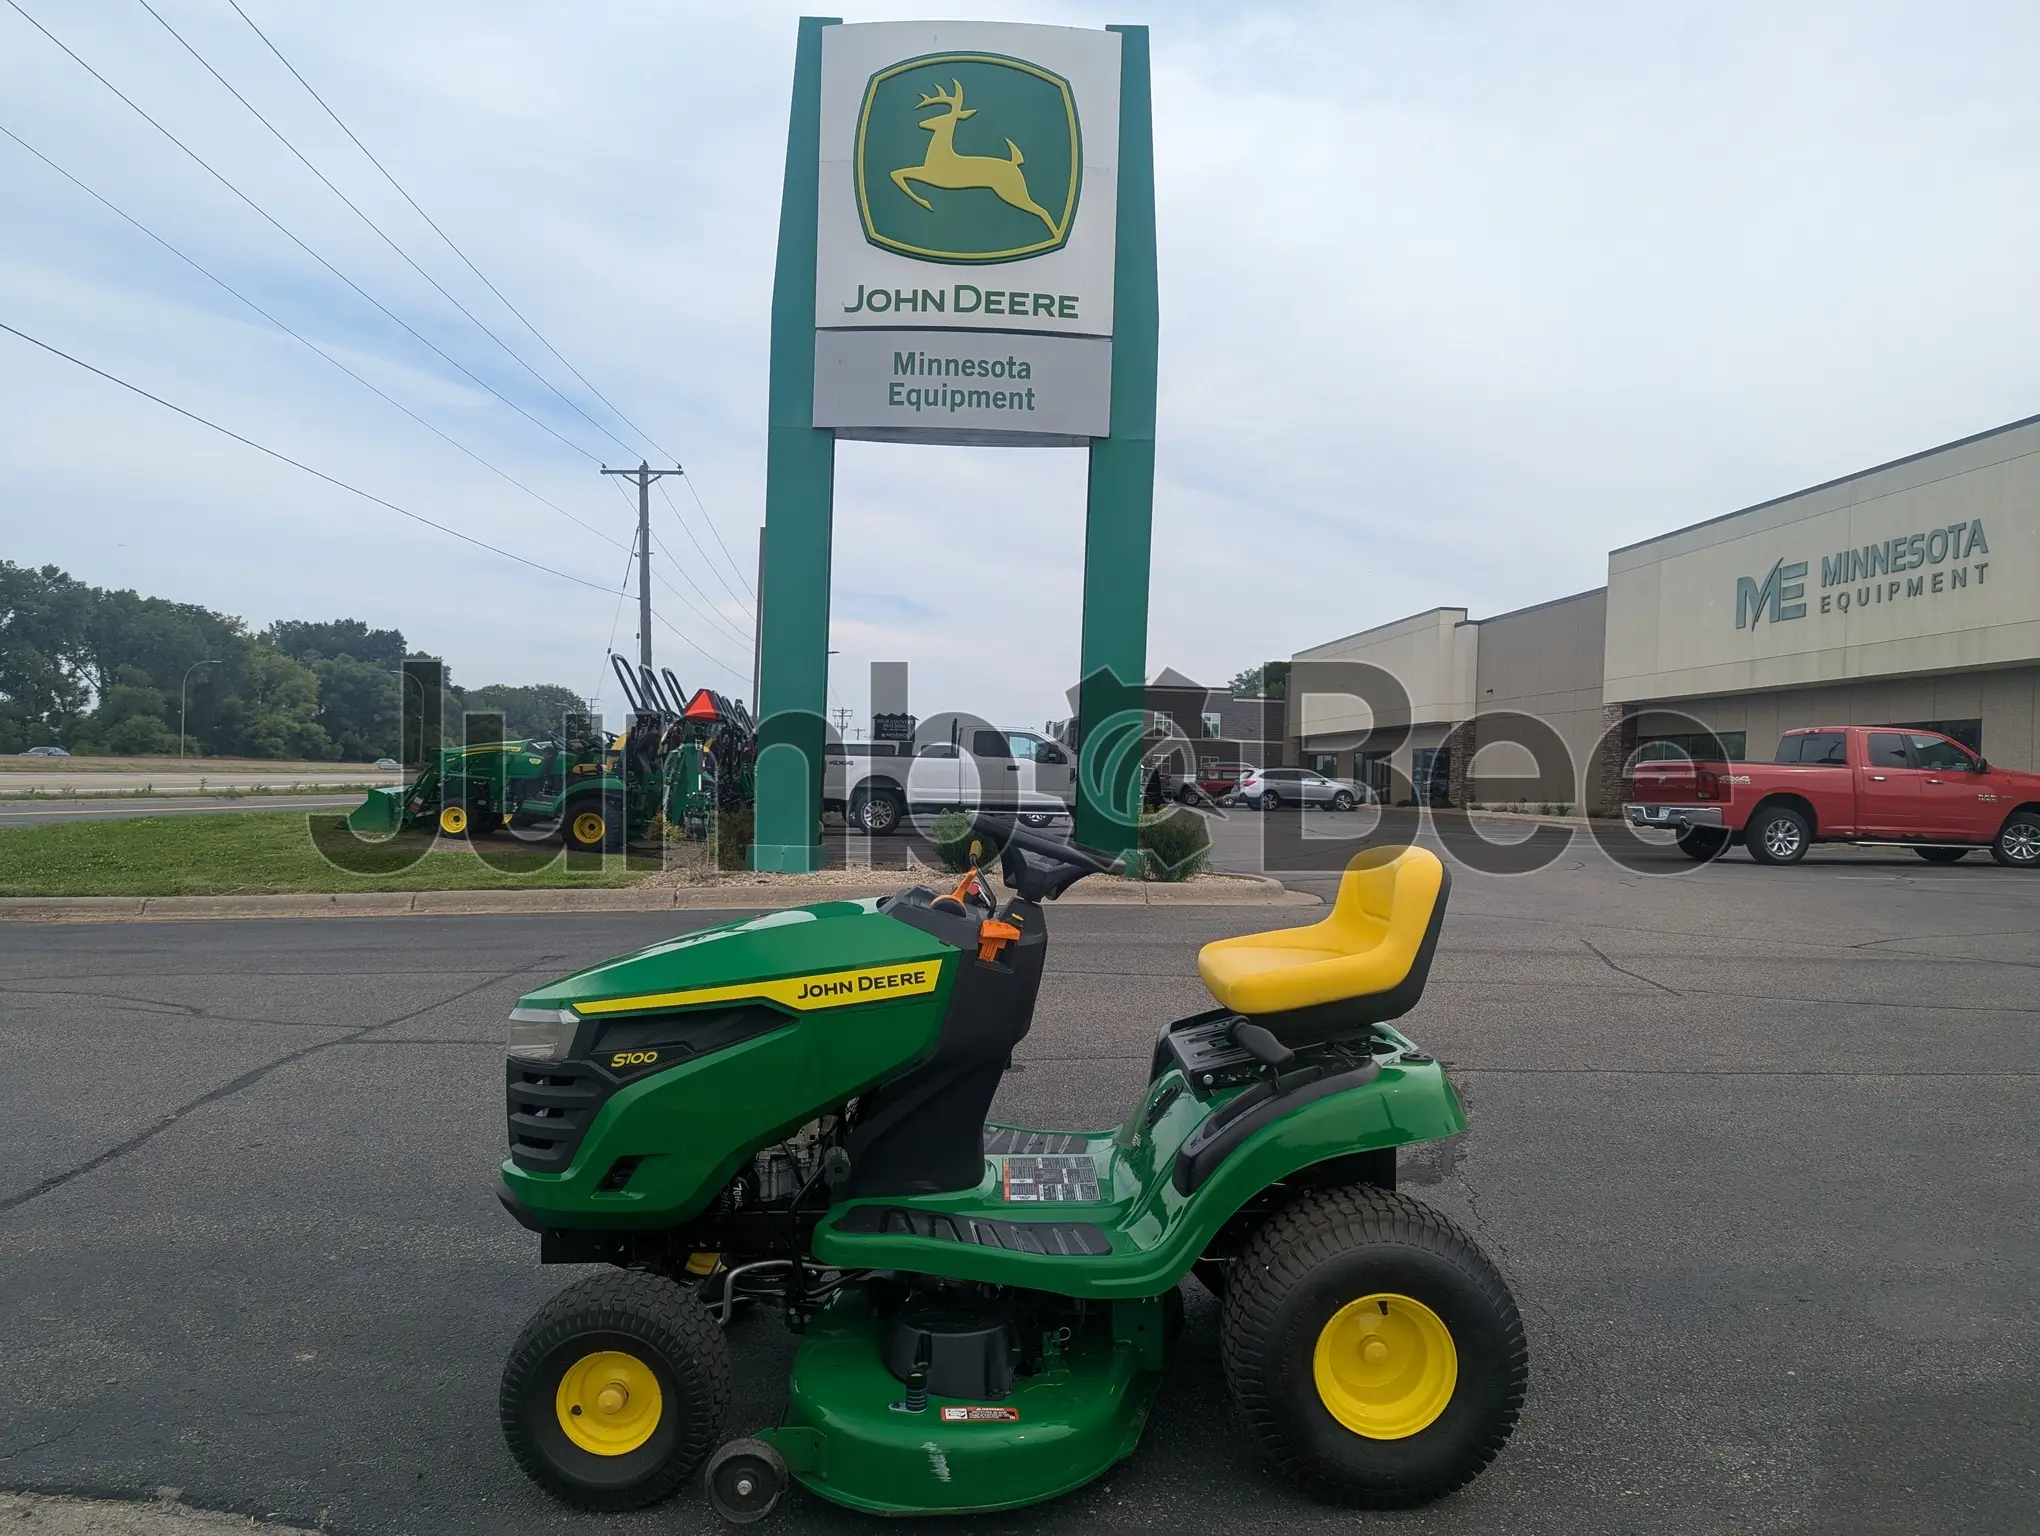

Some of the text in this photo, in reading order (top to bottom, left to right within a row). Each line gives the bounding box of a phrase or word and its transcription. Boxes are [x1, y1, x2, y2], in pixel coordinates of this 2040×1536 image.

[844, 284, 1079, 319] JOHN DEERE
[893, 351, 1031, 380] Minnesota
[888, 382, 1036, 413] Equipment
[1820, 518, 1989, 588] MINNESOTA
[1820, 562, 1989, 614] EQUIPMENT
[797, 970, 926, 1000] JOHN DEERE
[611, 1050, 658, 1068] S100
